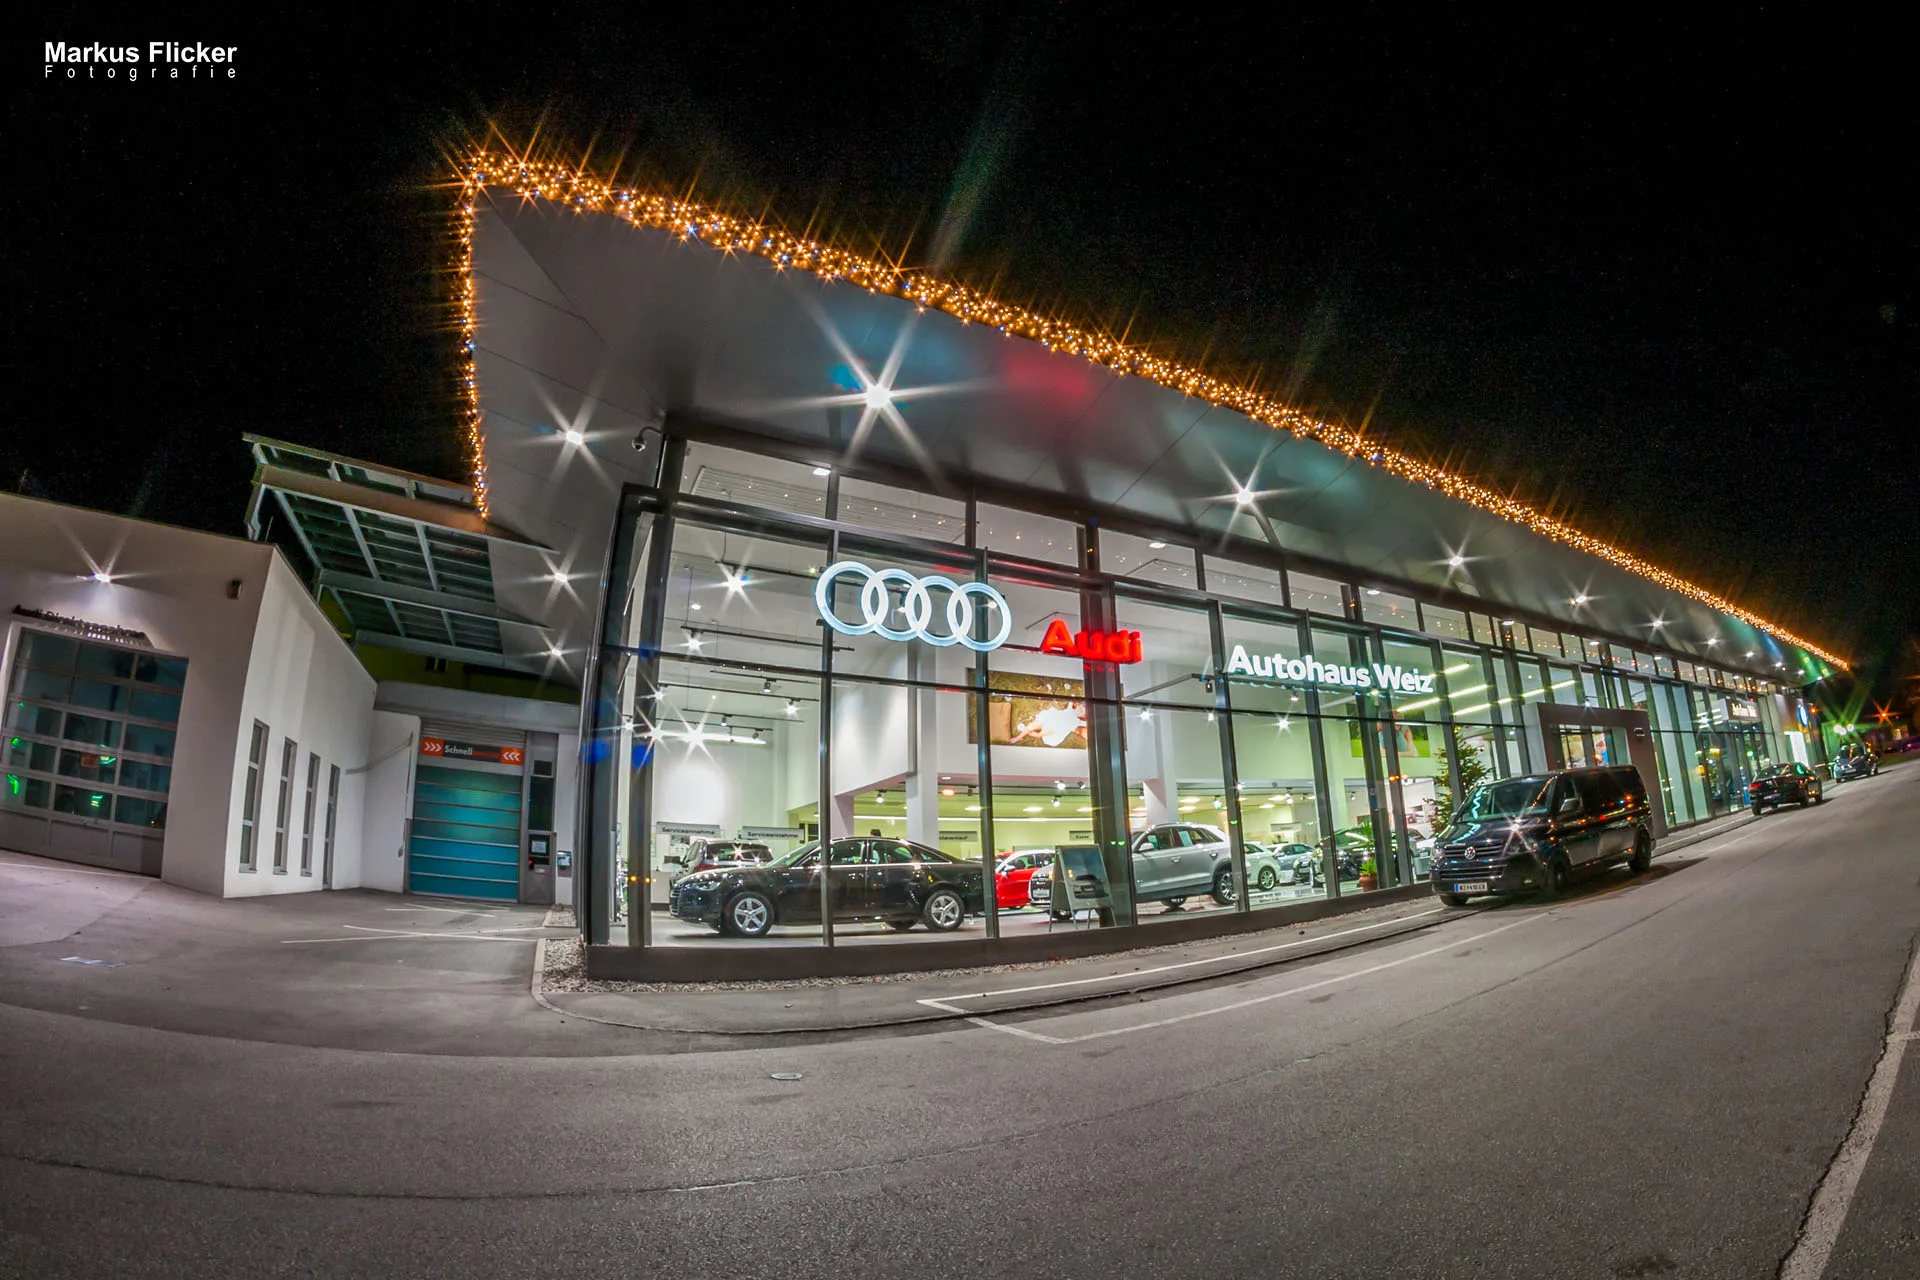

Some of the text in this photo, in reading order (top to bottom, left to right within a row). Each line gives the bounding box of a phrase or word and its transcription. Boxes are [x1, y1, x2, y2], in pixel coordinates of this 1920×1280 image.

[1040, 619, 1142, 664] Audi
[1227, 645, 1433, 692] Autohaus Weiz
[445, 744, 473, 756] Schnell
